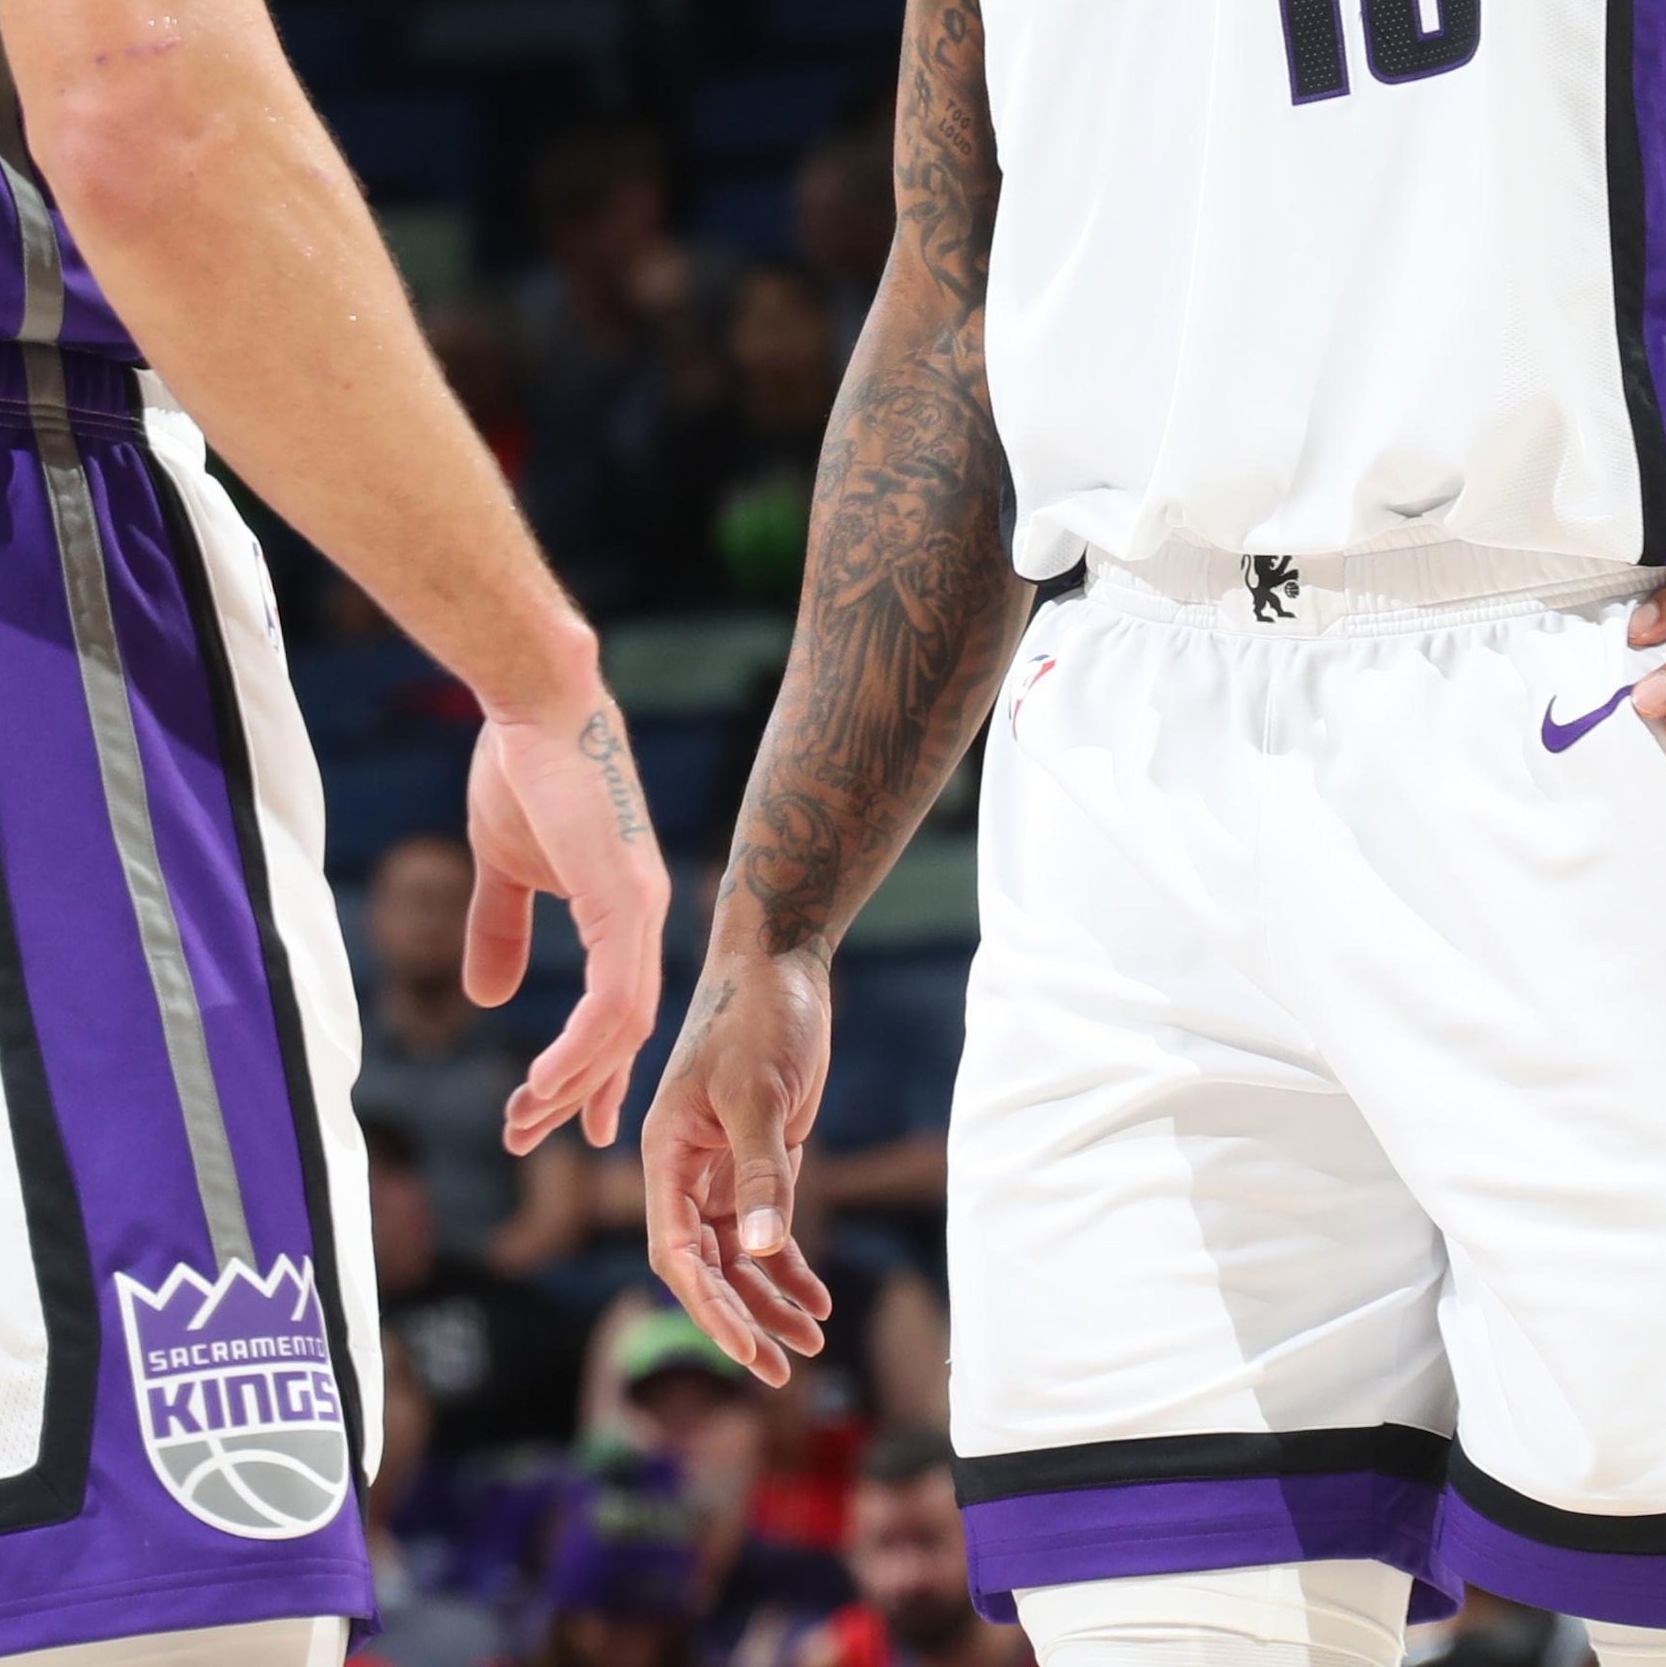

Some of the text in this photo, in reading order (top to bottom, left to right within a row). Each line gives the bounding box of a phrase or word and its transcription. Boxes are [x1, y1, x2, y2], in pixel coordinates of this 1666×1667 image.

[945, 99, 972, 130] TOO
[939, 118, 972, 156] LOUD
[148, 1335, 326, 1371] SACRAMENTO
[147, 1371, 341, 1440] KINGS
